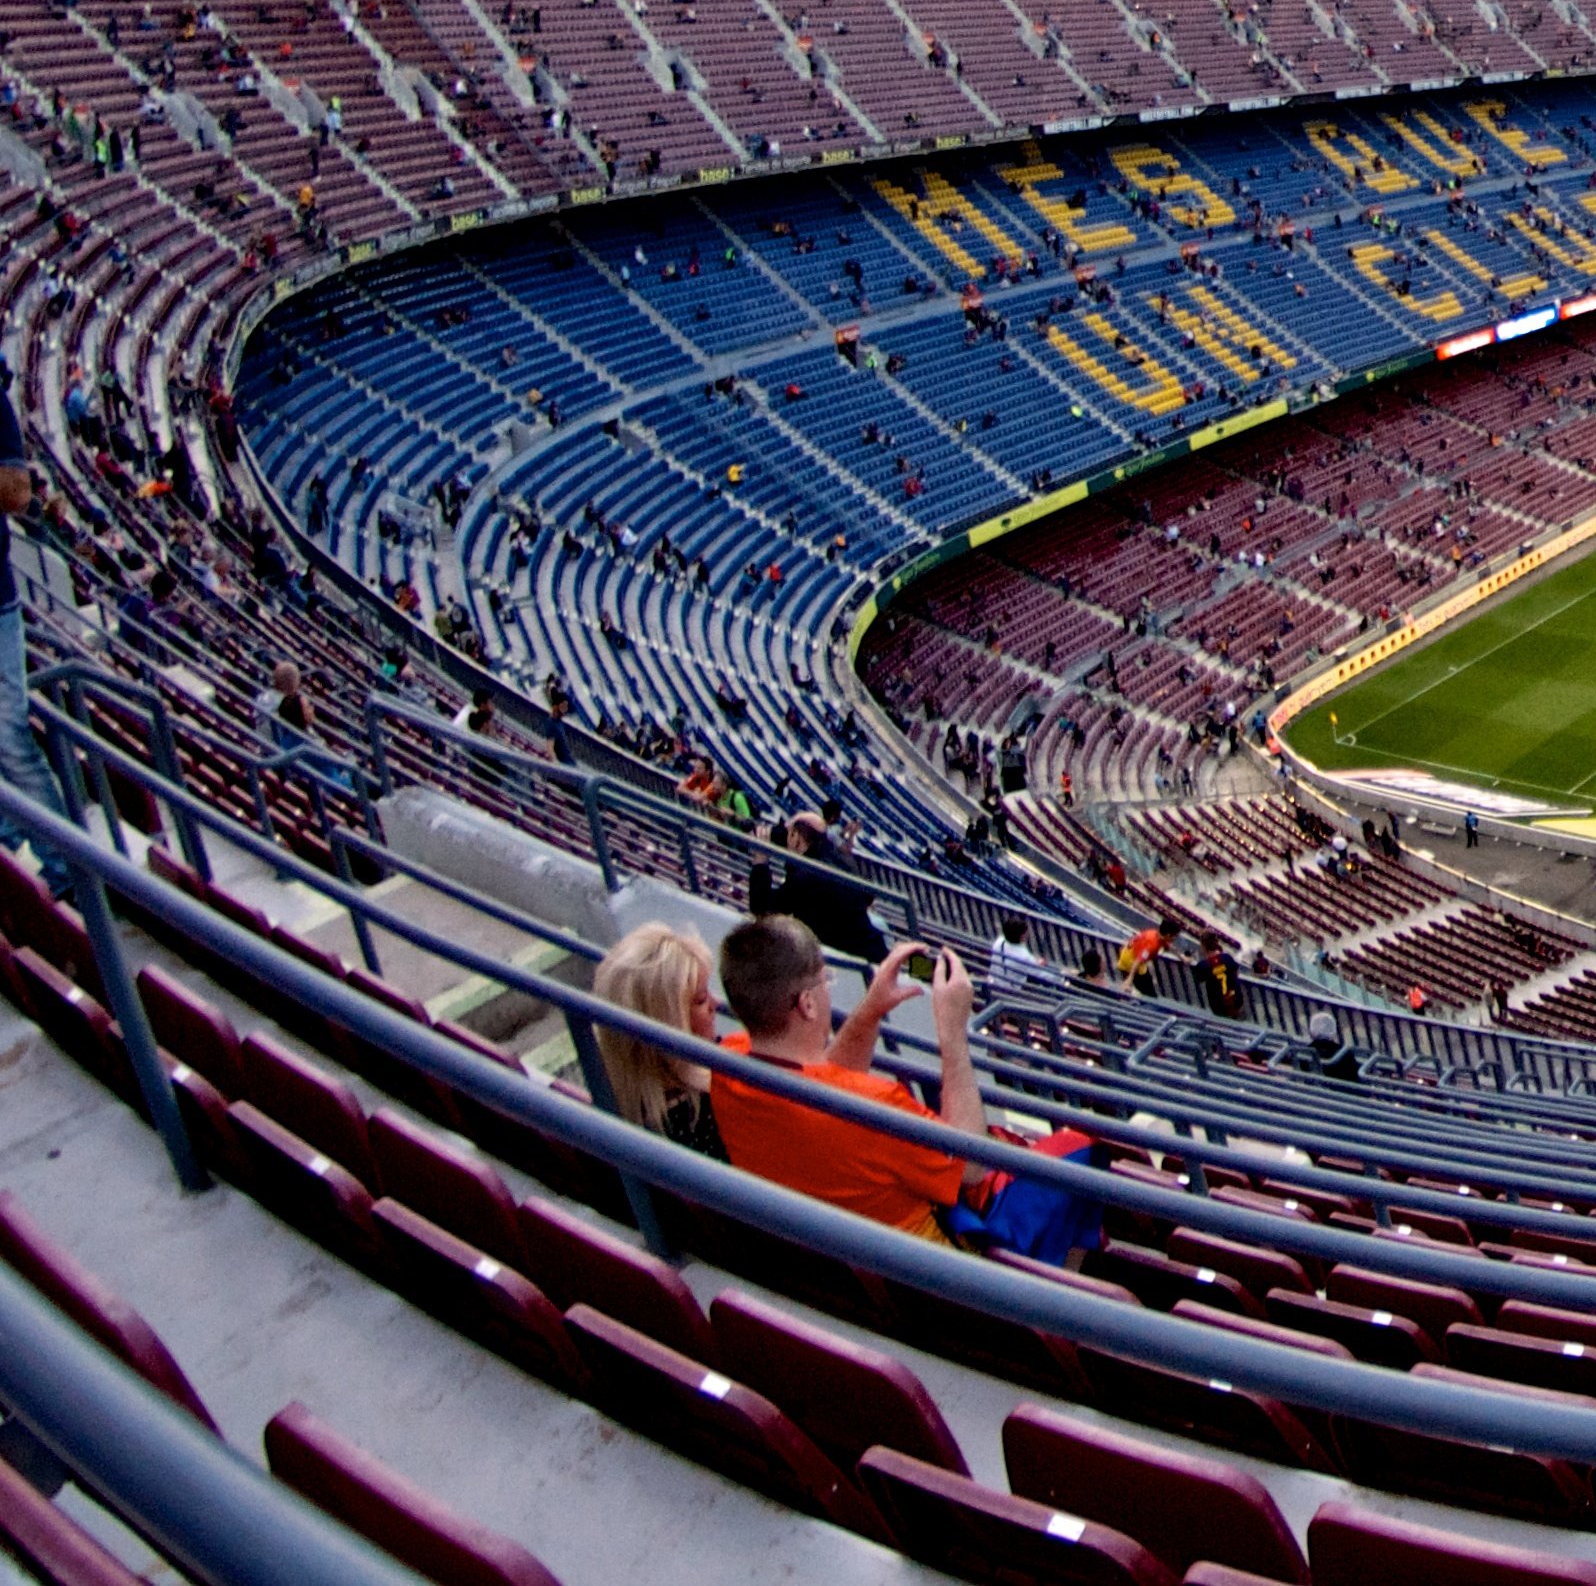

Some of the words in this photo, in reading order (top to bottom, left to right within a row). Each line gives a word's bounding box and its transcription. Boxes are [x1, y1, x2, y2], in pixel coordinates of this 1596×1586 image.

[871, 140, 1236, 279] MÉS
[1303, 99, 1568, 194] QUE
[1048, 285, 1298, 416] UN
